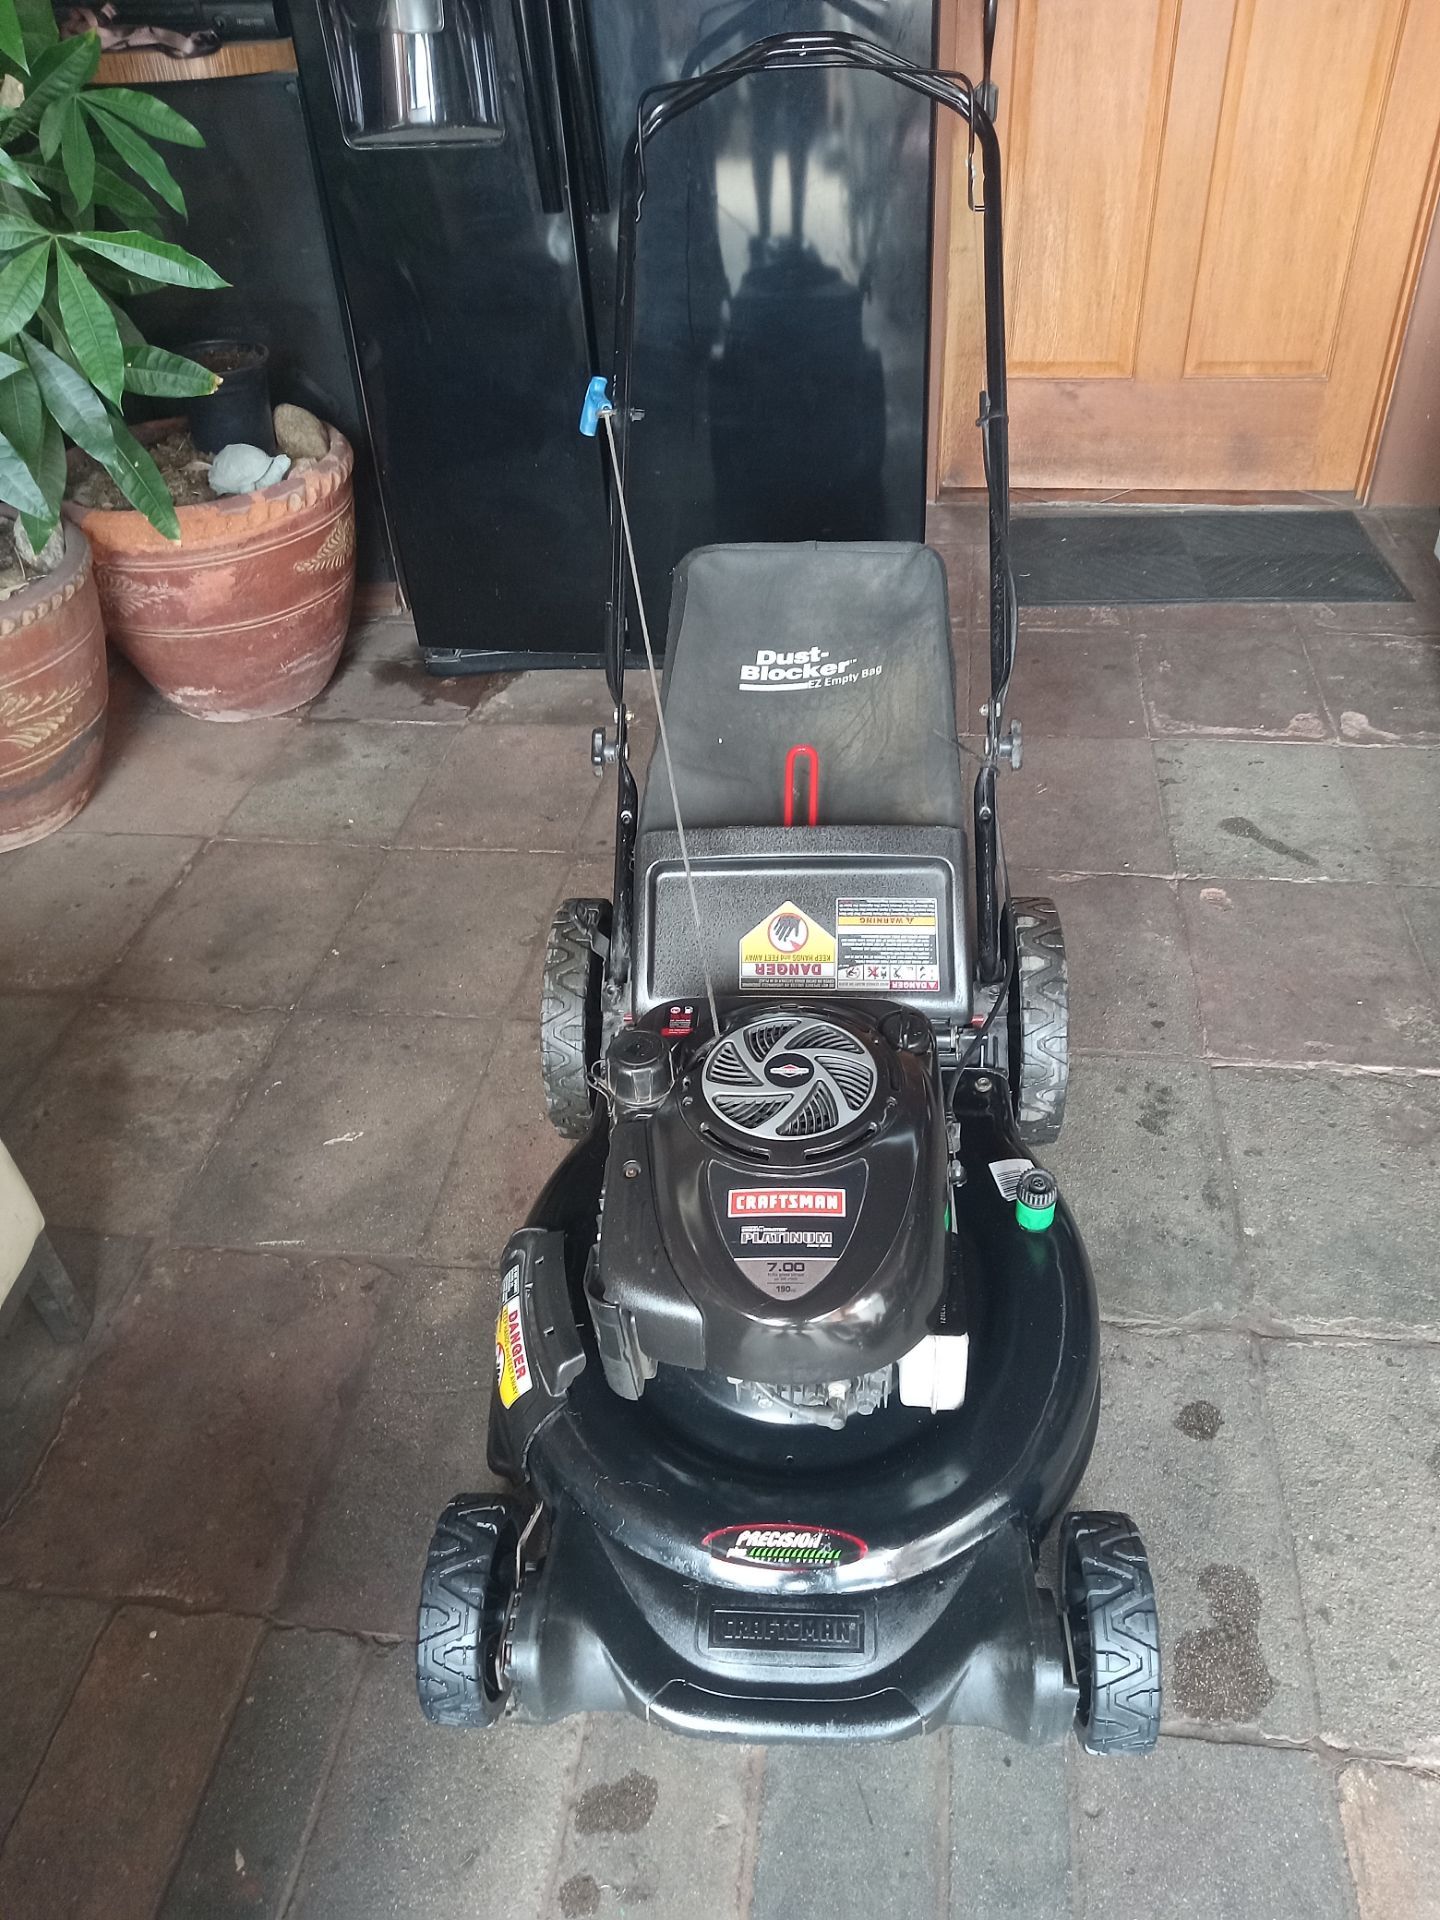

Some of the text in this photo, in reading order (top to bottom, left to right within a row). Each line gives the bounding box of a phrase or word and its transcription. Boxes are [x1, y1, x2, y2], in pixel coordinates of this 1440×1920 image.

[756, 646, 830, 665] Dust-
[808, 665, 882, 689] EZ Empty Bag
[755, 963, 822, 976] DANGER
[891, 981, 928, 990] DANGER
[735, 1194, 838, 1210] CRAFTSMAN
[740, 1231, 833, 1245] PLATINUM
[766, 1262, 805, 1272] 7.00
[508, 1309, 526, 1381] DANGER
[723, 1620, 850, 1643] CRAFTSMAN
